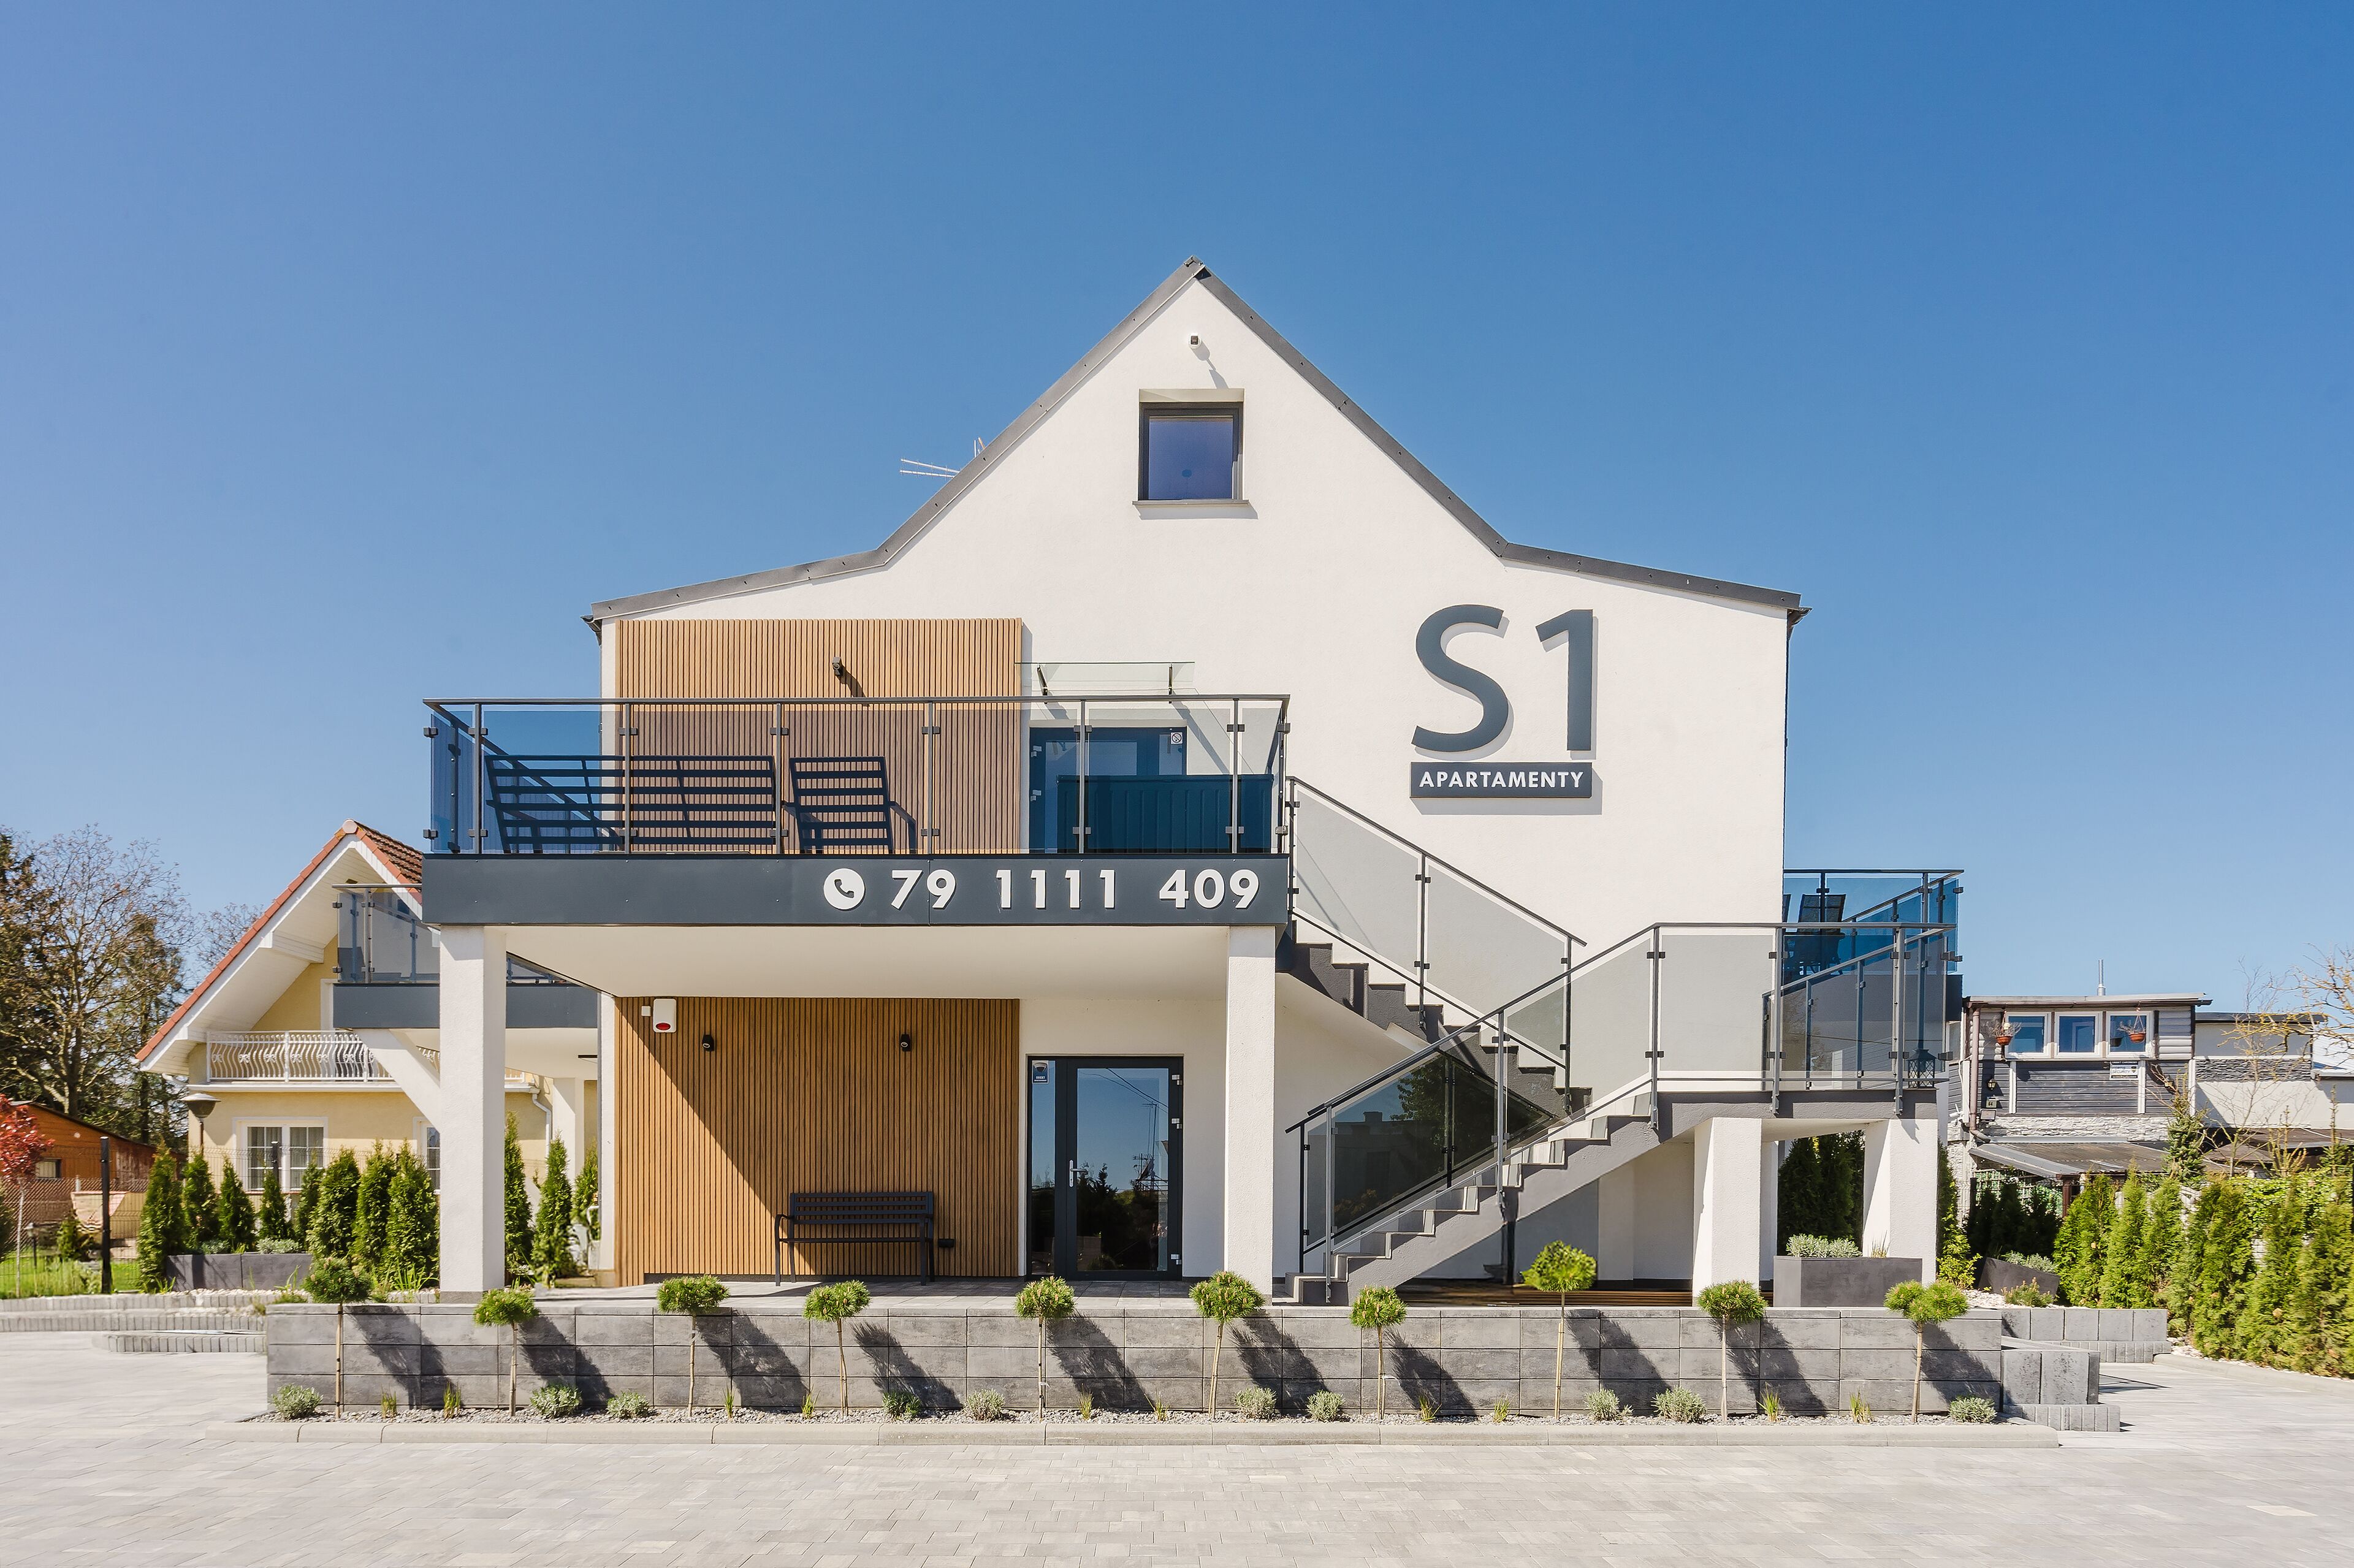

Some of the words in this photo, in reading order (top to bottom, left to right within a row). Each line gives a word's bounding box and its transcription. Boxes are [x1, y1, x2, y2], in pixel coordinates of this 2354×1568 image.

[1411, 604, 1593, 752] S1
[1419, 771, 1584, 788] APARTAMENTY
[891, 869, 956, 909] 79
[996, 869, 1115, 908] 1111
[1159, 869, 1259, 908] 409
